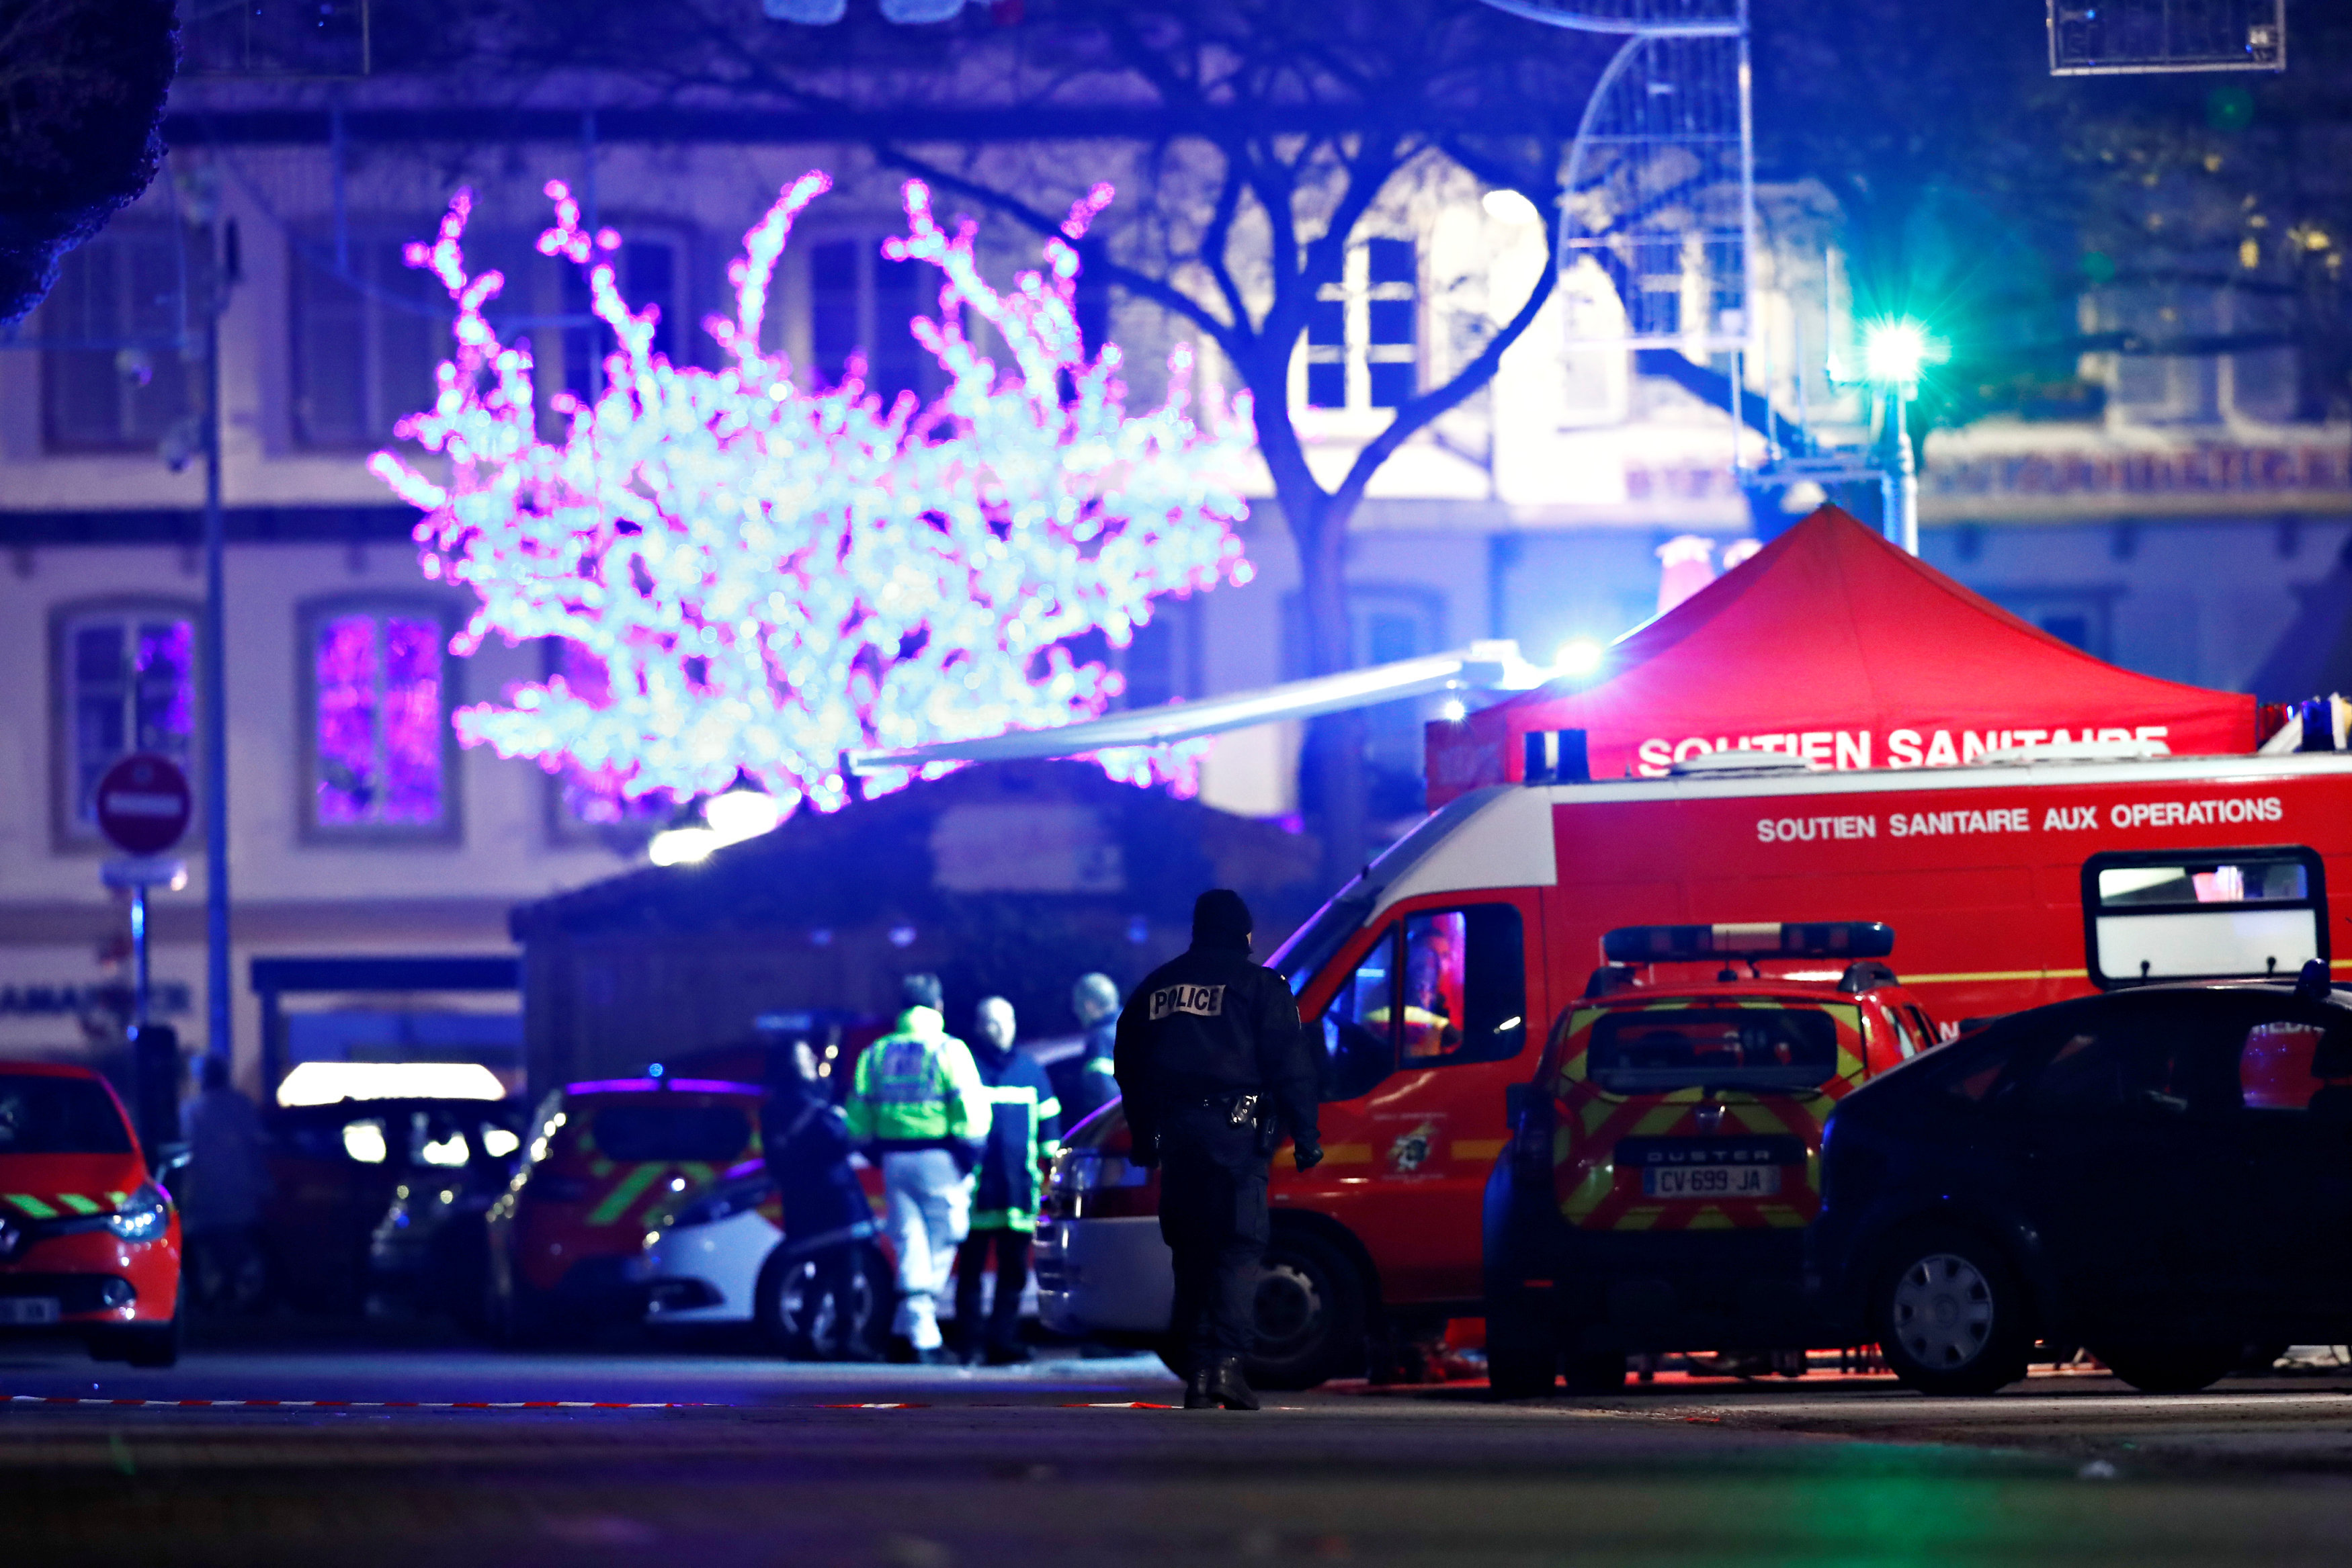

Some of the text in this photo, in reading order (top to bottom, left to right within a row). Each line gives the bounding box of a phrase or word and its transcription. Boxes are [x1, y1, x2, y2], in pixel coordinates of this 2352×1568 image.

[1756, 797, 2283, 843] SOUTIEN SANITAIRE AUX OPERATIONS
[1154, 986, 1220, 1014] POLICE
[1647, 1150, 1770, 1162] DUSTER
